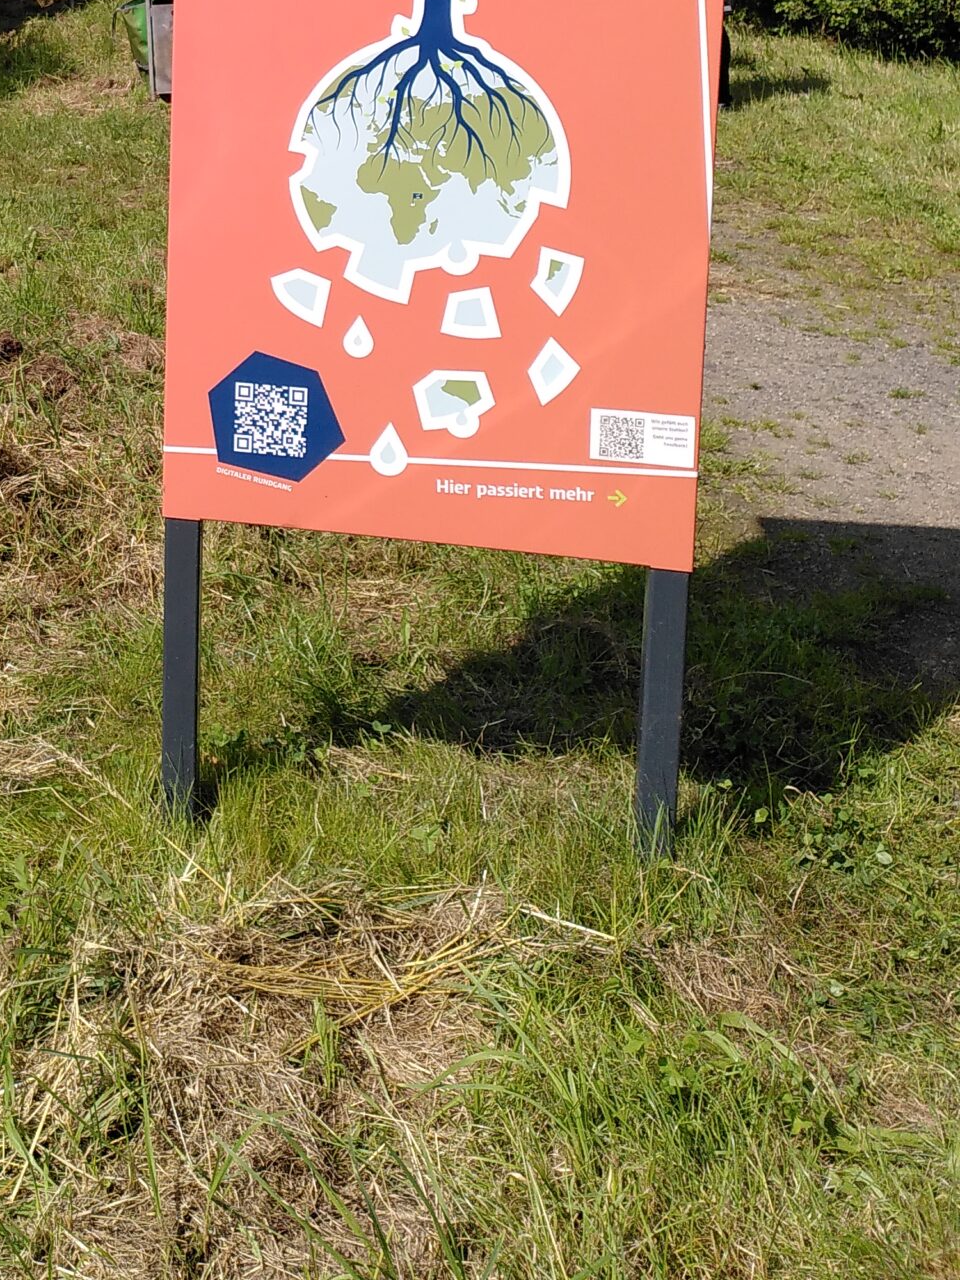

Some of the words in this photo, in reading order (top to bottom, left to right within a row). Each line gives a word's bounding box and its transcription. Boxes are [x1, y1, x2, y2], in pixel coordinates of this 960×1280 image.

[216, 466, 252, 482] DIGITALER
[252, 476, 293, 492] RUNDGANG
[436, 479, 471, 495] Hier
[476, 483, 544, 499] passiert
[549, 487, 595, 502] mehr
